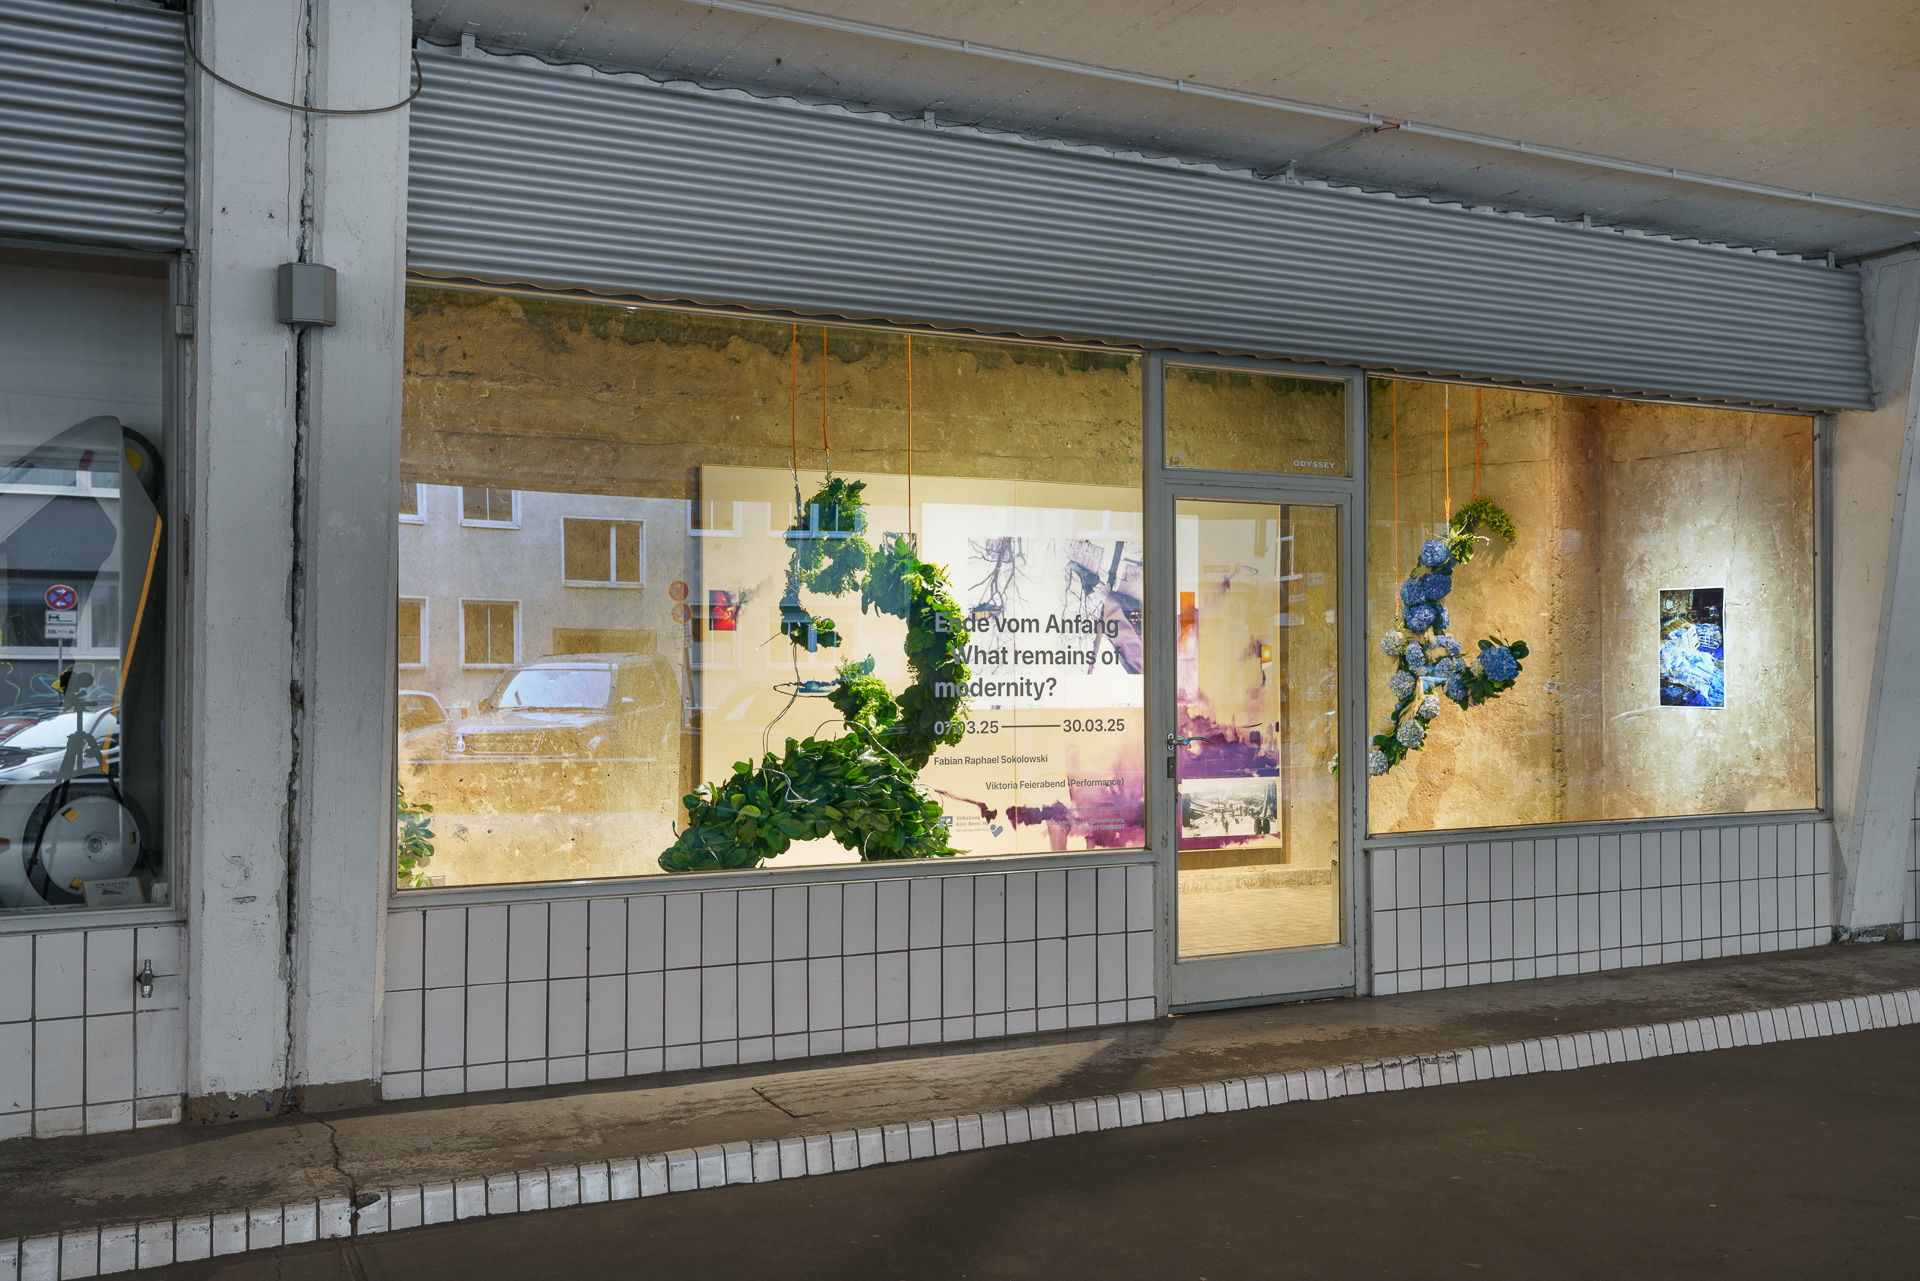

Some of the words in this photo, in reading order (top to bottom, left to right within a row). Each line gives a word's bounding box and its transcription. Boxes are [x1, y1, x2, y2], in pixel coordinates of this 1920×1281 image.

[1293, 460, 1335, 469] ODYSSEY
[935, 612, 990, 633] Ende
[995, 617, 1040, 633] vom
[1045, 614, 1119, 638] Anfang
[951, 645, 1009, 665] What
[1014, 645, 1096, 665] remains
[1101, 646, 1121, 665] of
[935, 677, 1057, 701] modernity?
[934, 721, 999, 736] 07.03.25
[1063, 719, 1125, 733] 30.03.25
[934, 756, 963, 766] Fabian
[964, 756, 999, 767] Raphael
[1001, 754, 1048, 764] Sokolowski
[985, 781, 1018, 790] Viktoria
[1020, 779, 1065, 789] Feierabend
[1068, 777, 1124, 789] (Performance)
